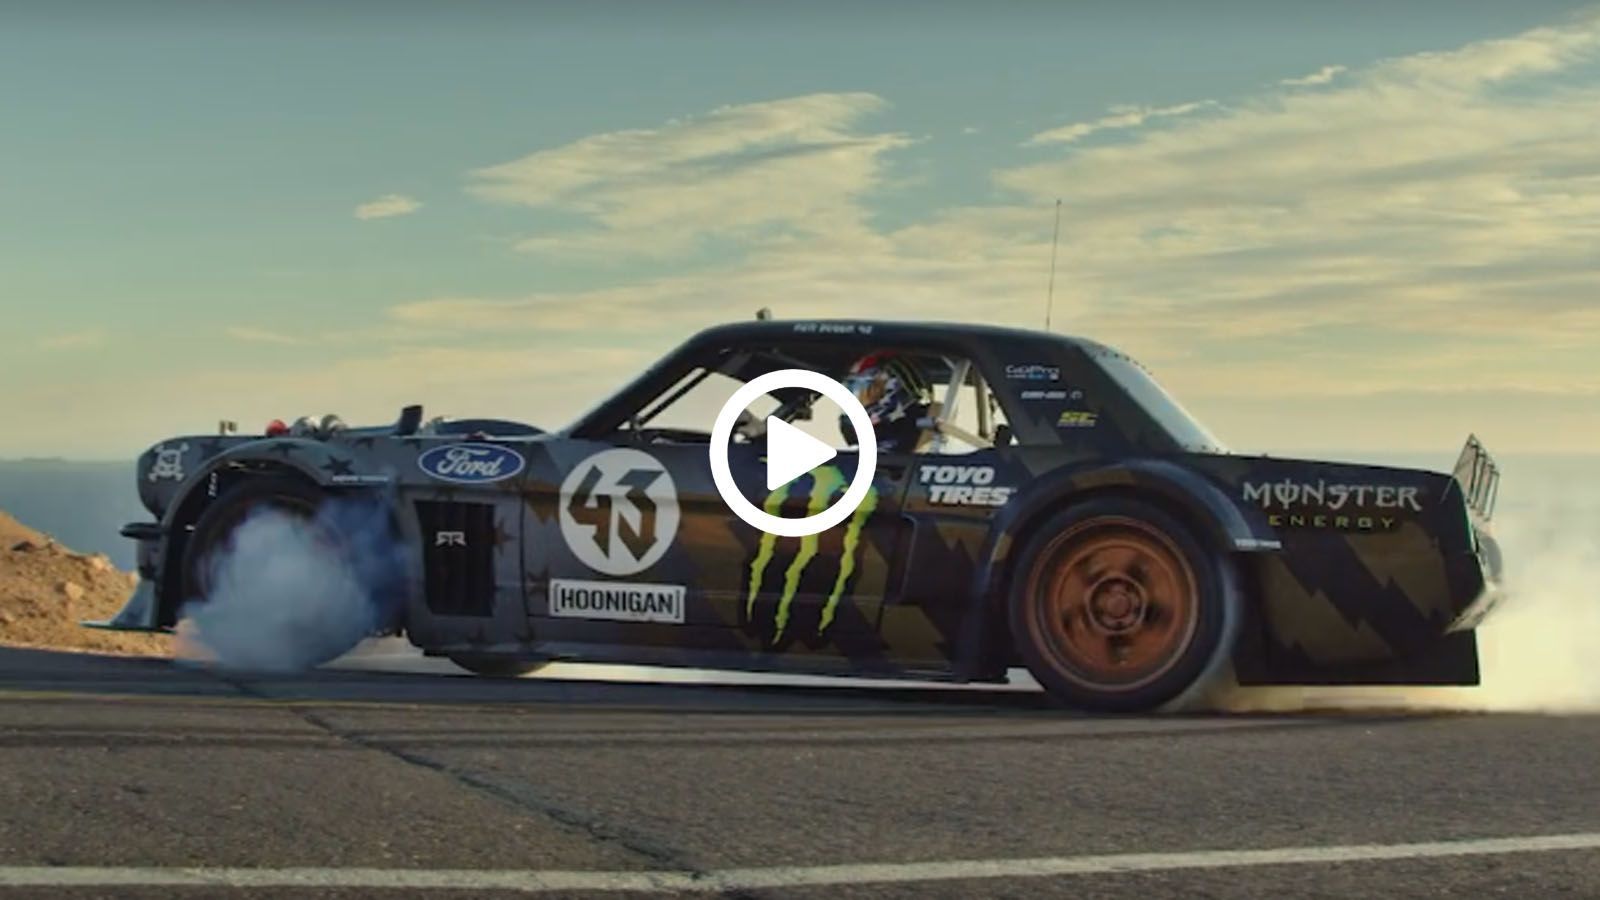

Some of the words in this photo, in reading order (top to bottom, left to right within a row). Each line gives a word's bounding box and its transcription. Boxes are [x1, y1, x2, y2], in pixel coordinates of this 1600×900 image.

[436, 446, 505, 476] Ford
[920, 465, 995, 485] TOYO
[929, 485, 1010, 506] TIRES
[1242, 478, 1423, 512] MONSTER
[1267, 514, 1395, 529] ENERGY
